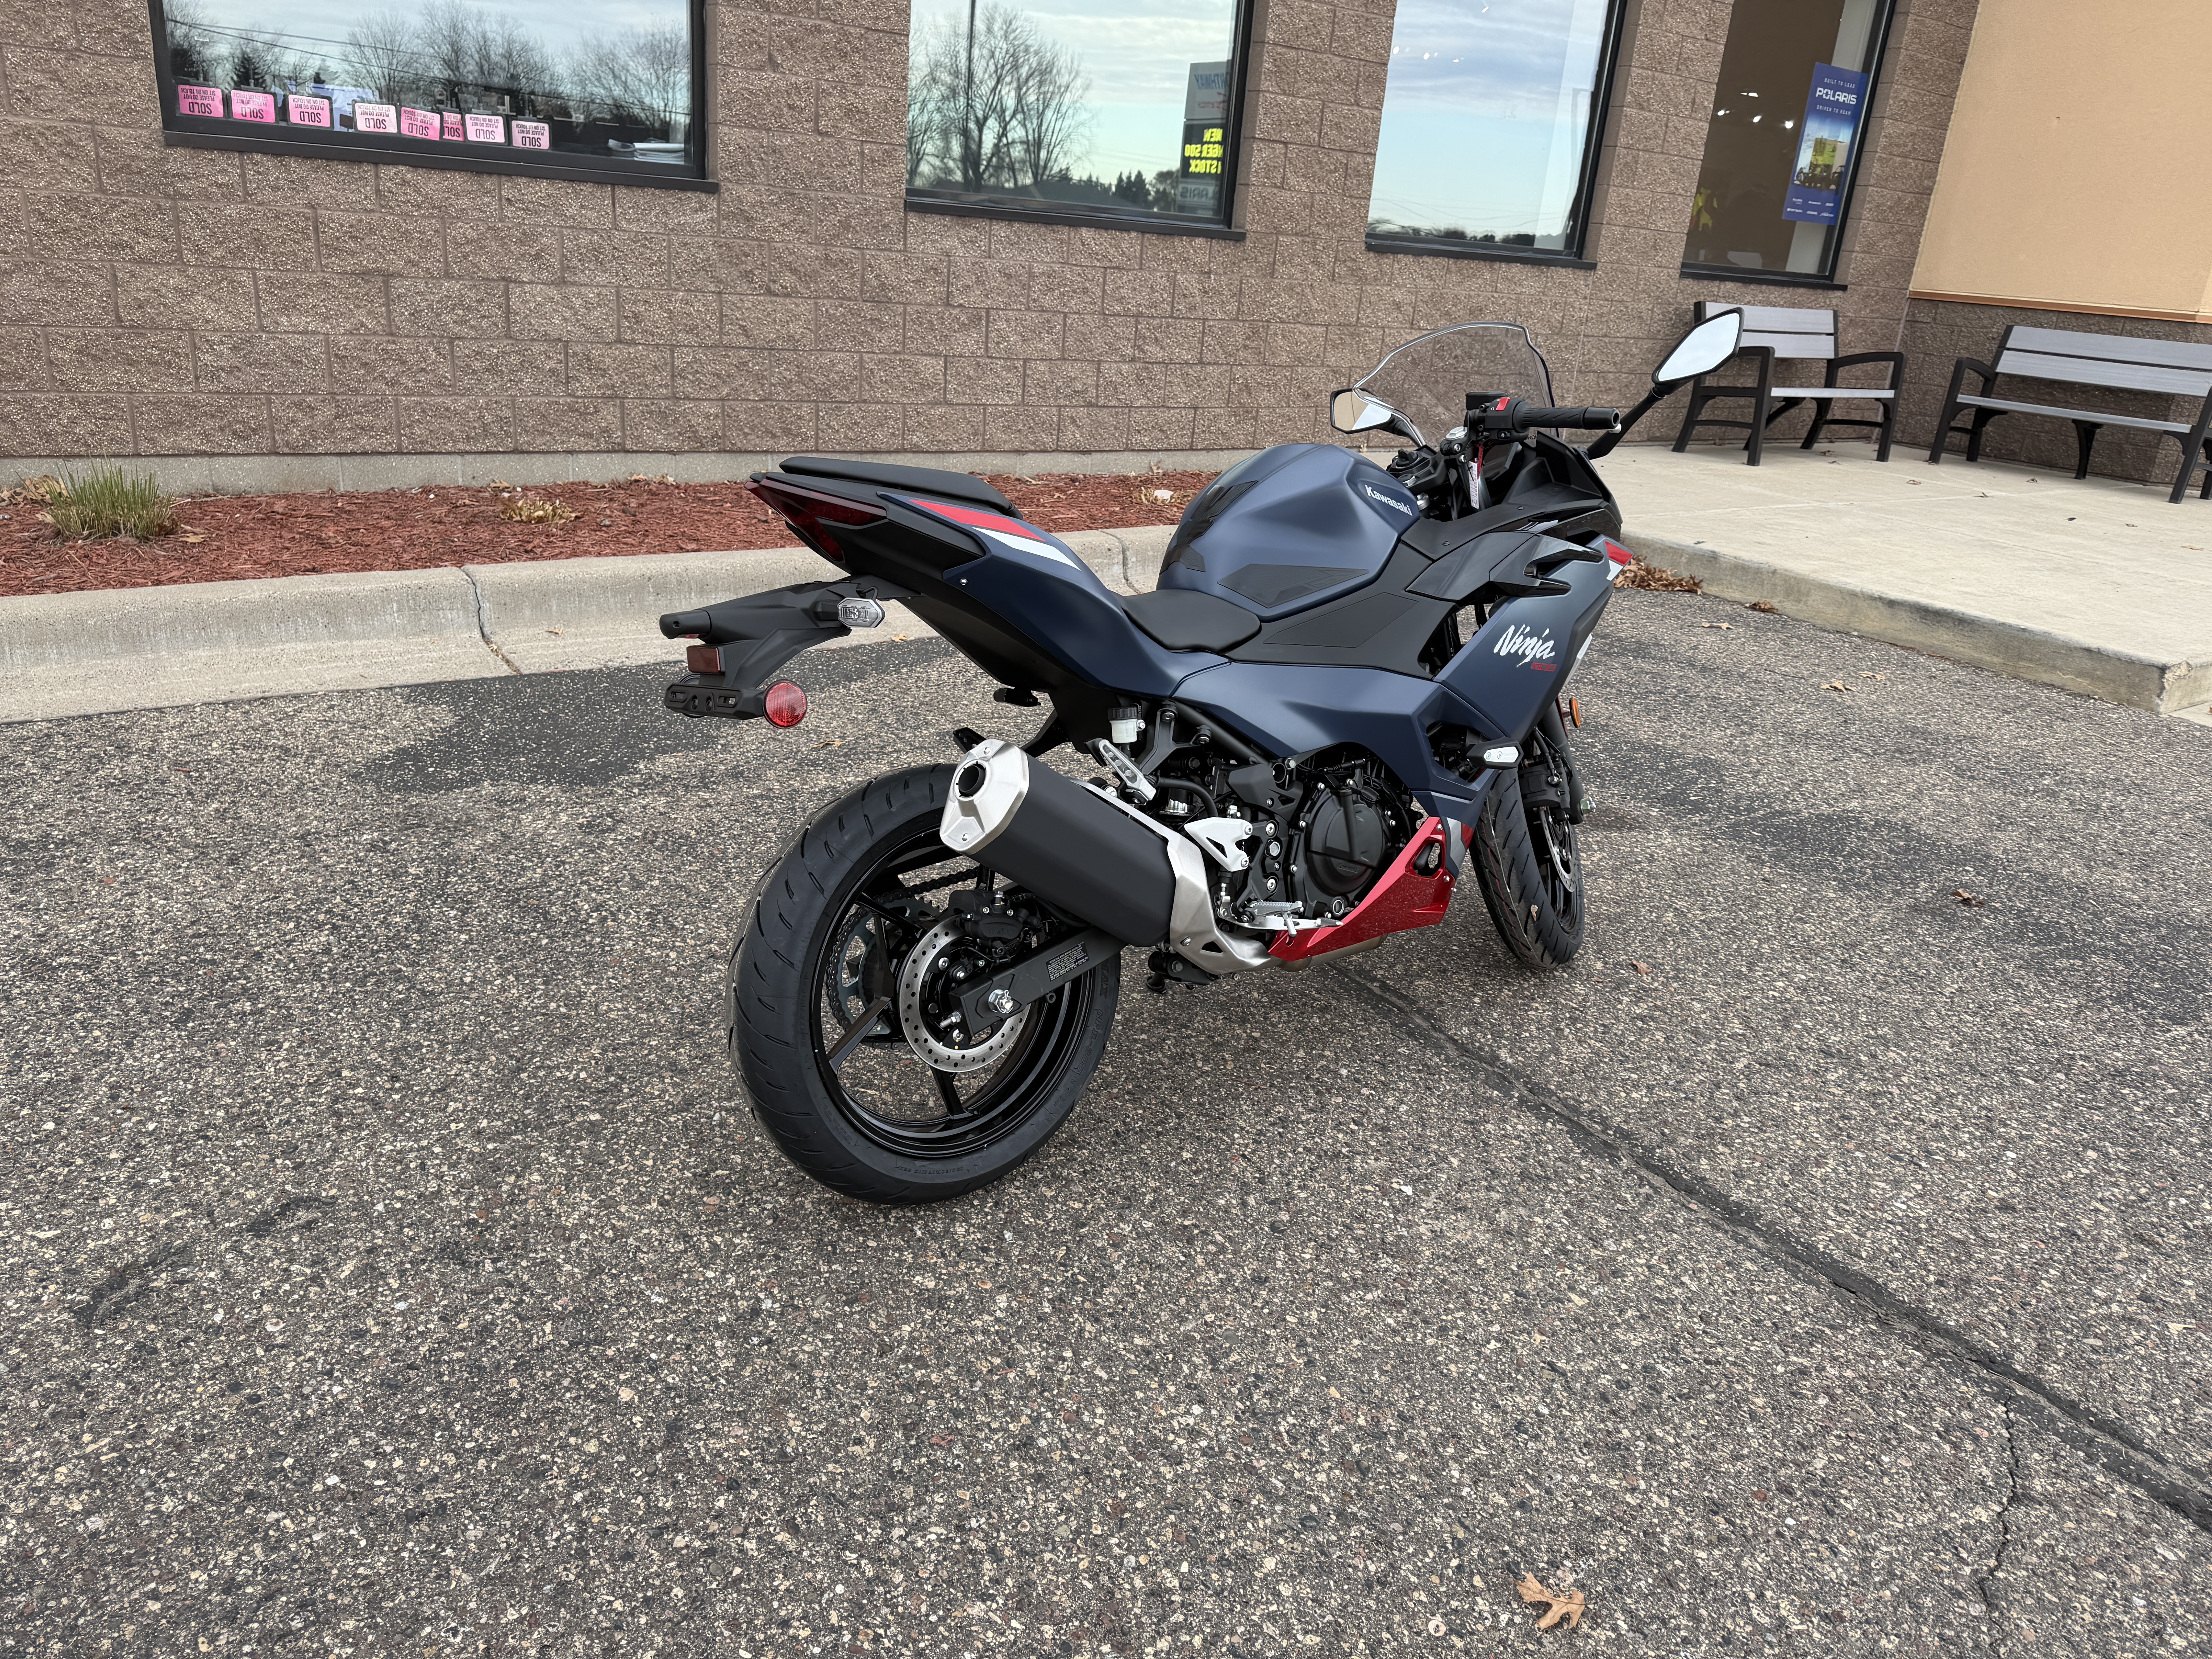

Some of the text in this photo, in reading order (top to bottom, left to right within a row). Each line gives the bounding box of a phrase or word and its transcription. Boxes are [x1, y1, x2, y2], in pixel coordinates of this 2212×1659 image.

[1815, 87, 1857, 105] POLARIS
[189, 102, 212, 114] SOLD
[241, 107, 264, 119] SOLD
[300, 112, 321, 123] SOLD
[365, 118, 386, 129] SOLD
[408, 123, 429, 136] SOLD
[445, 126, 460, 137] SOL
[476, 129, 495, 140] SOLD
[522, 136, 541, 147] SOLD
[1365, 484, 1413, 516] Kawasaki
[1493, 624, 1555, 667] Ninja
